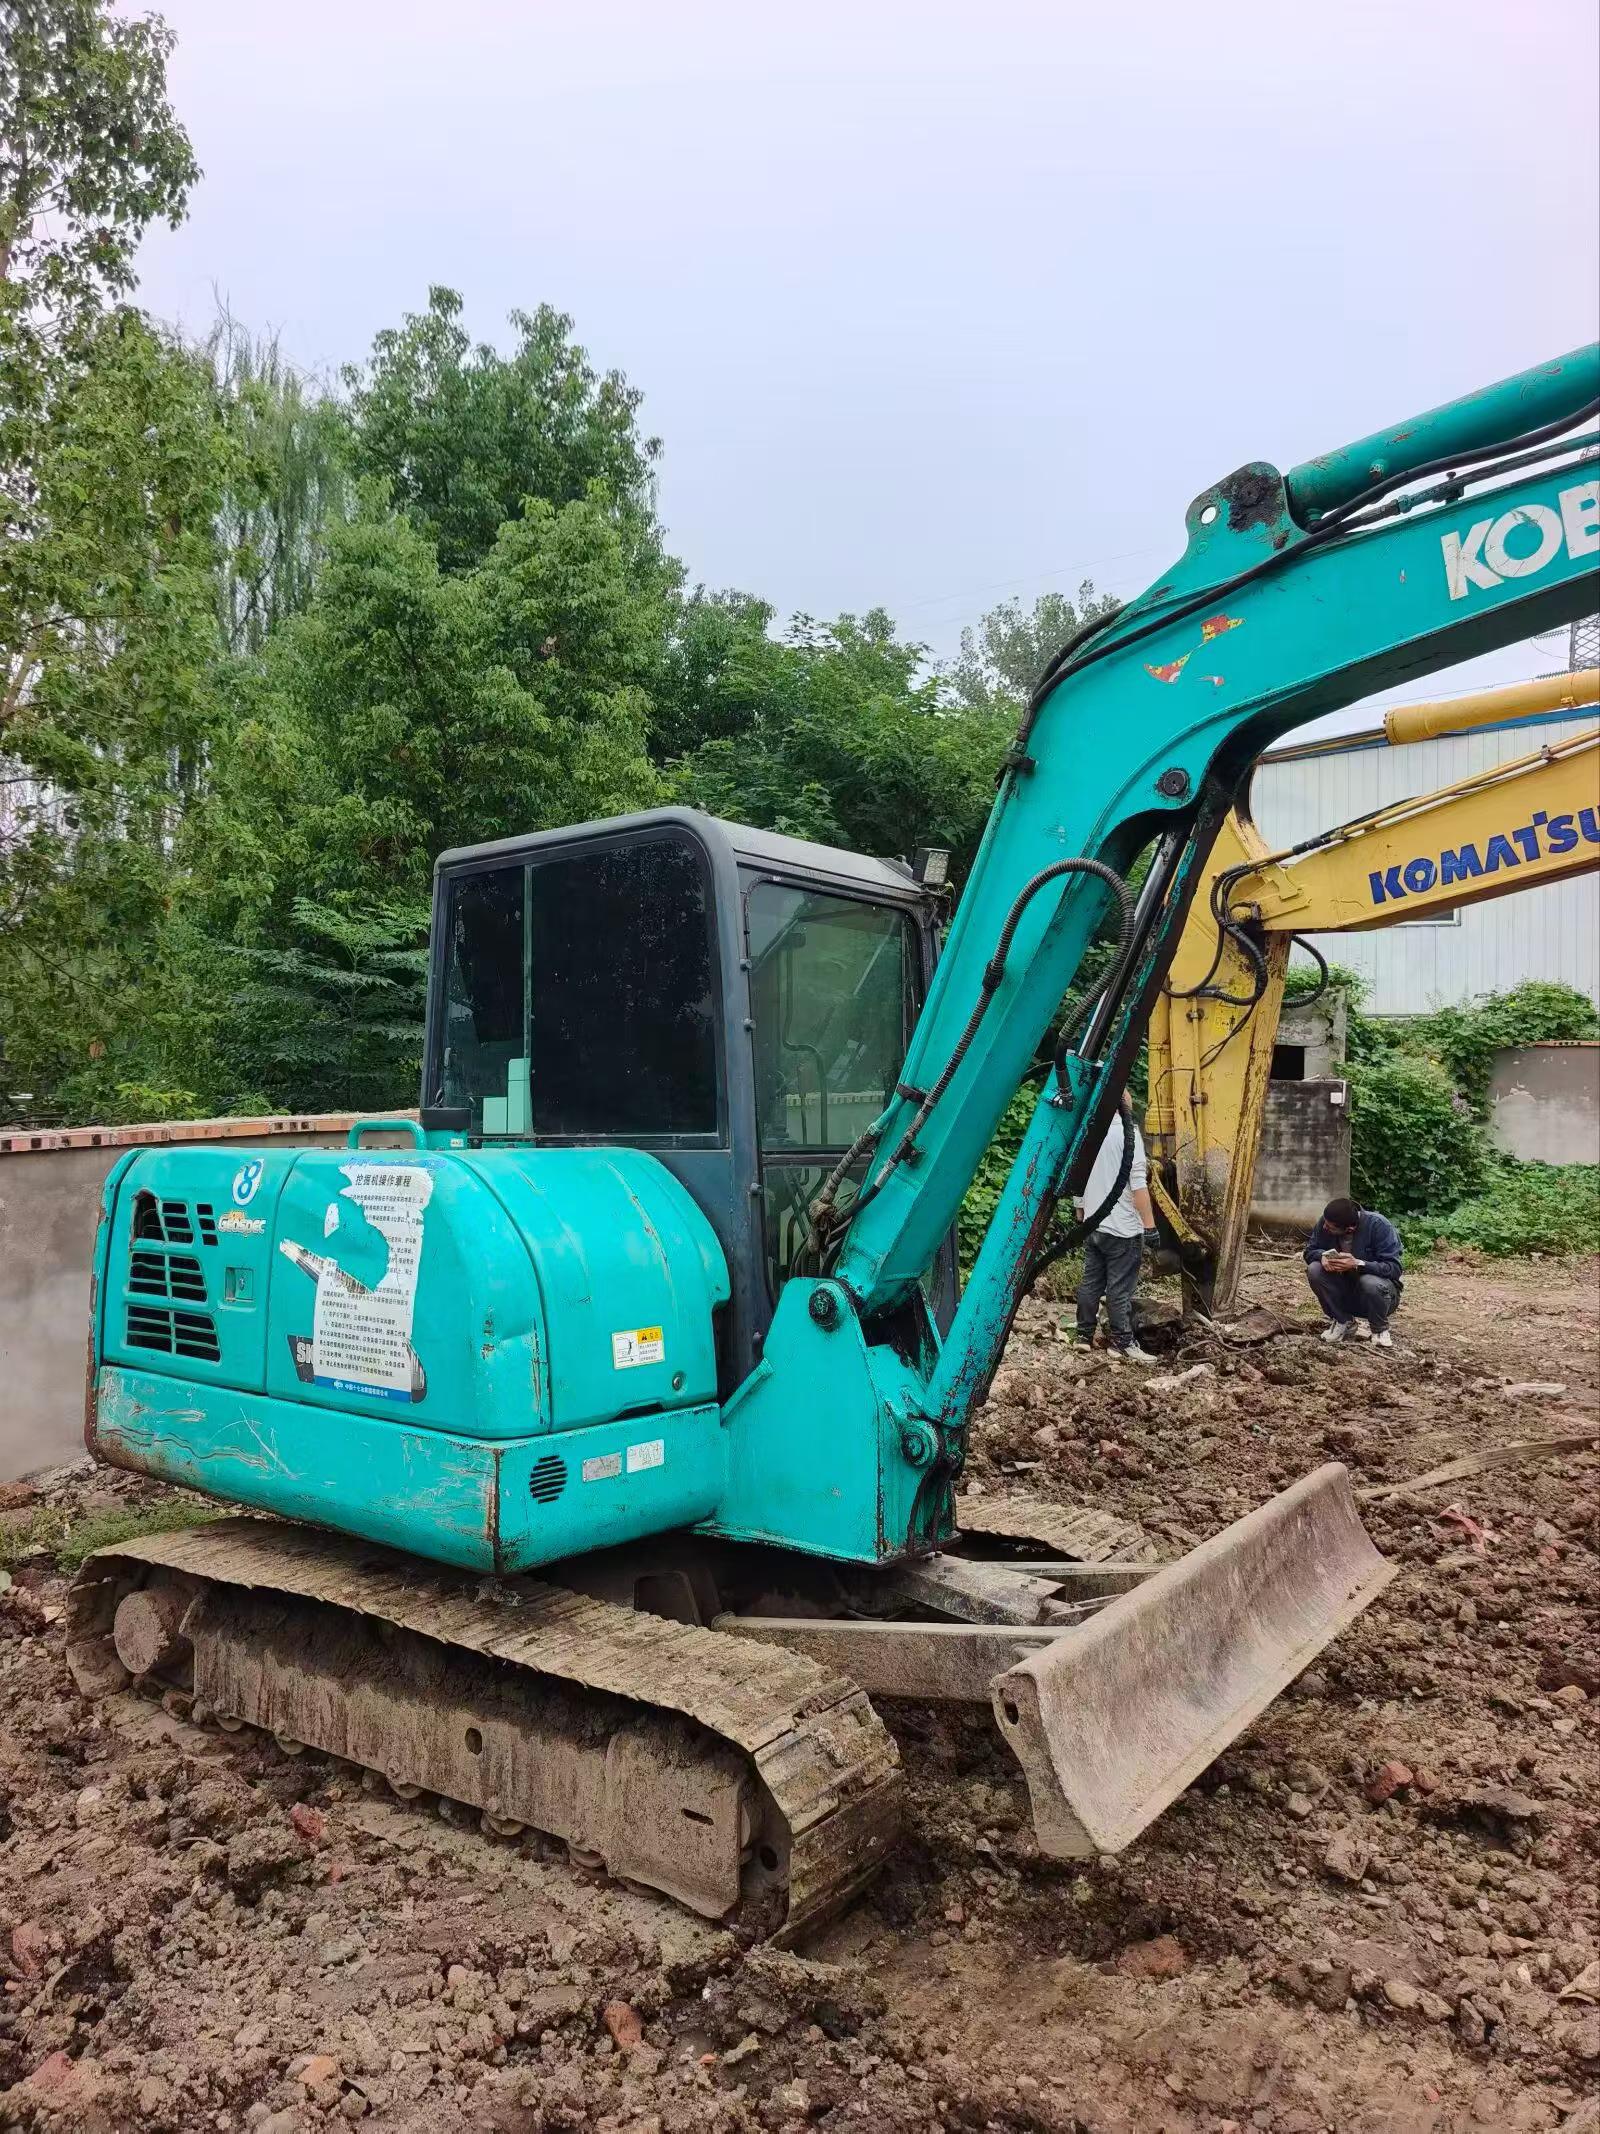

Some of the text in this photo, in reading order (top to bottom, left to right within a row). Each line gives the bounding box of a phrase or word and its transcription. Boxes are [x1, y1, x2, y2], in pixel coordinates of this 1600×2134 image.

[355, 1173, 412, 1188] 挖掘机操作章程
